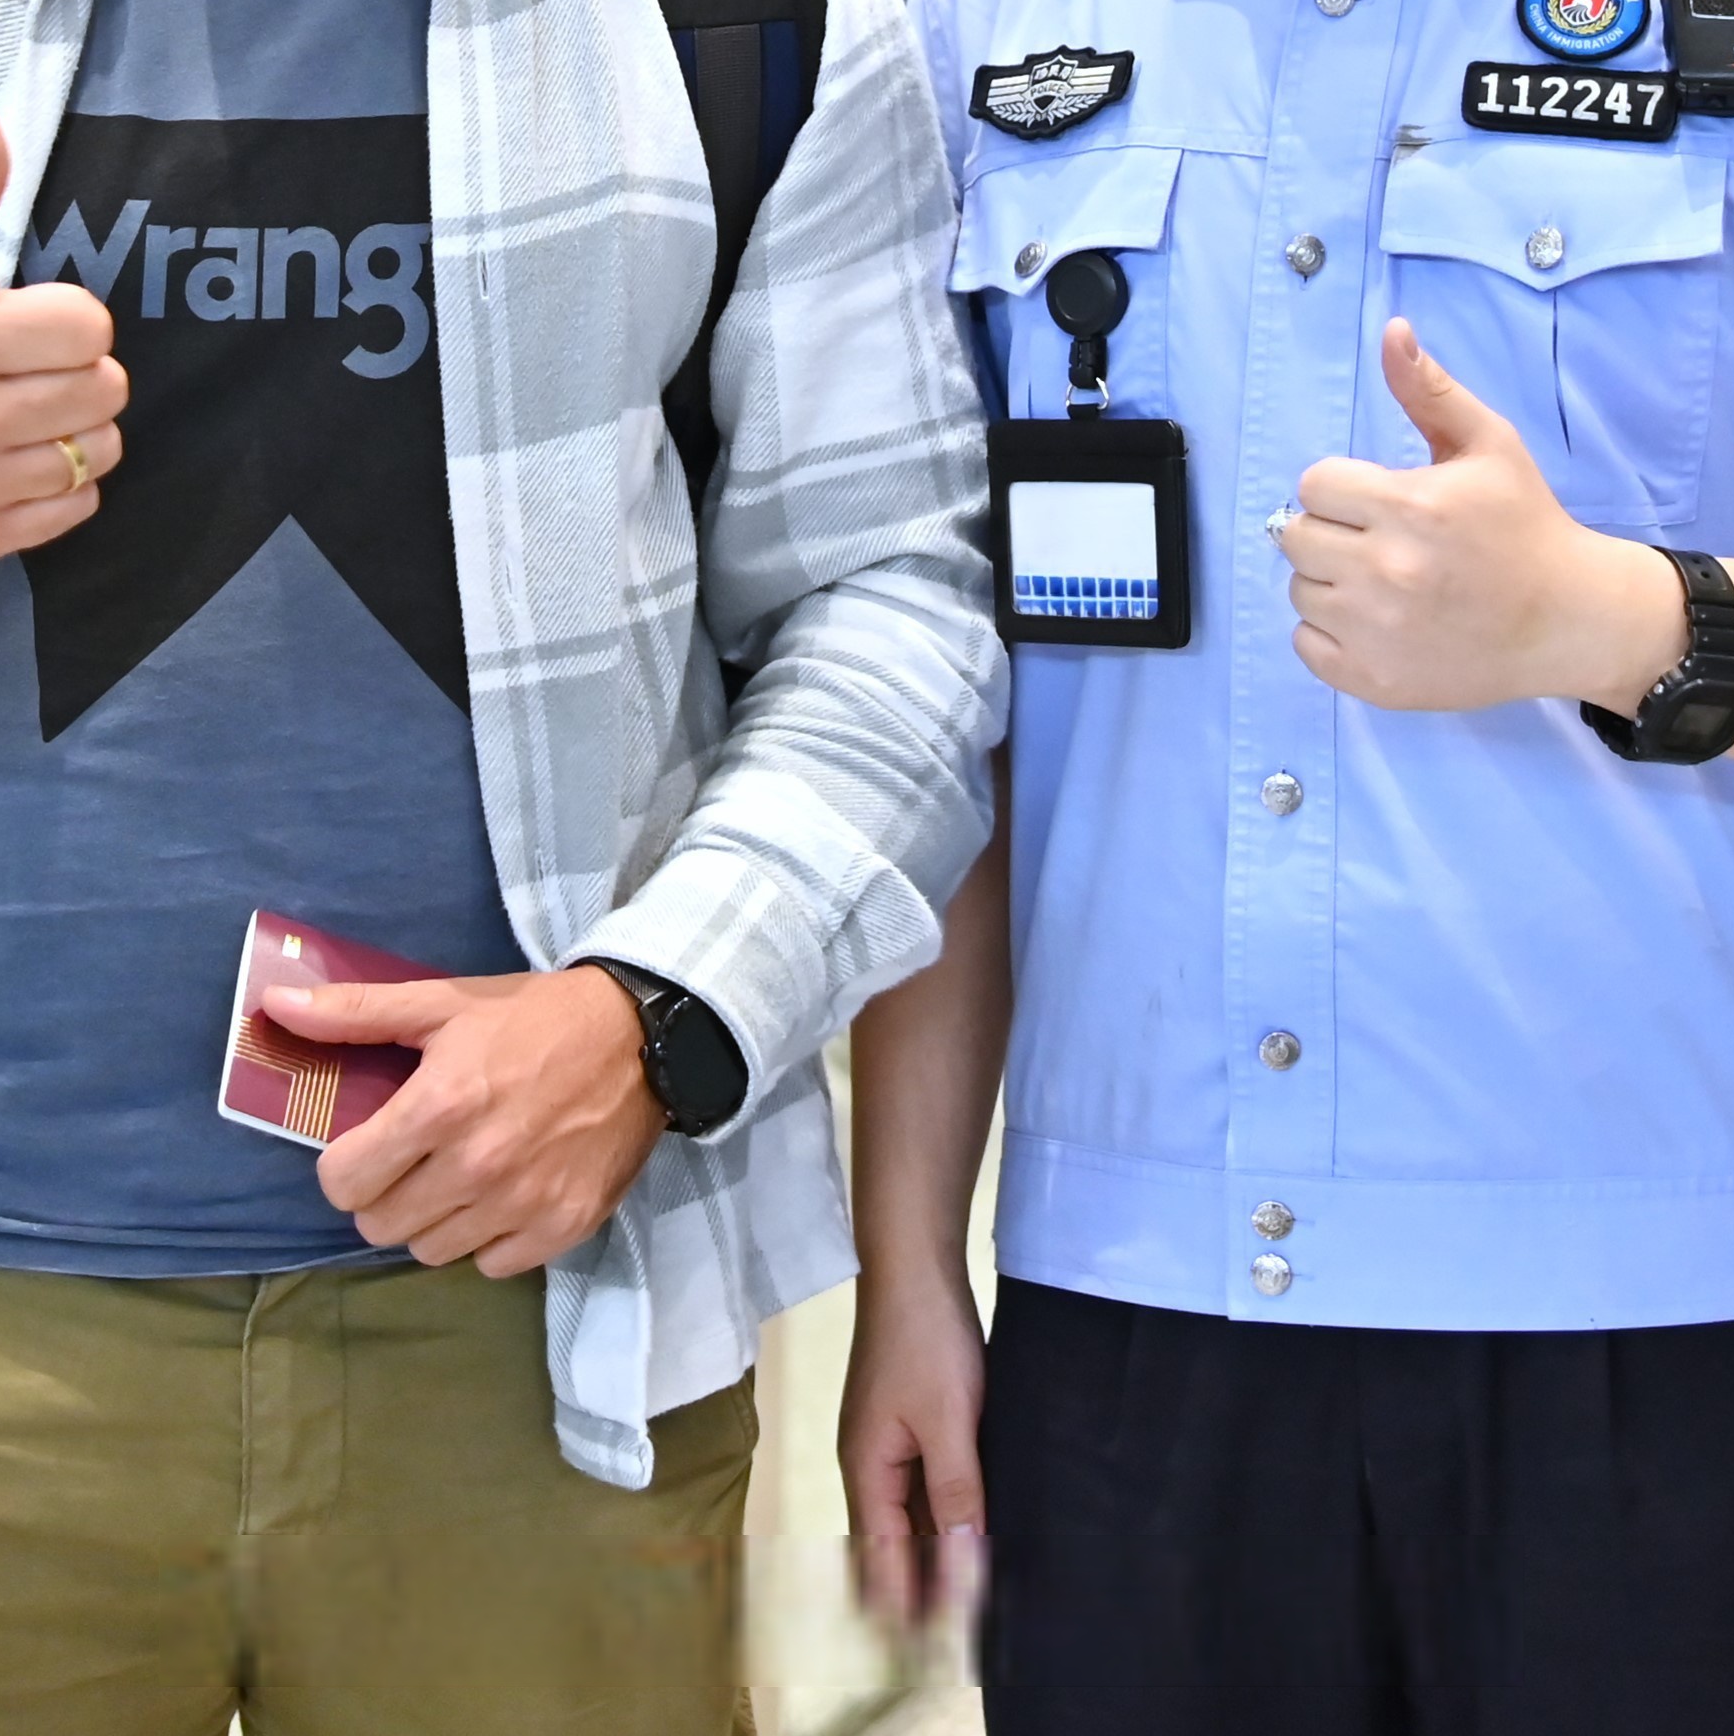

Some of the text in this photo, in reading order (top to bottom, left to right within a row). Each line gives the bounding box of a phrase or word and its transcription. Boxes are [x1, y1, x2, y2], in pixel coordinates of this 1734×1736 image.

[1547, 27, 1624, 50] IMMIGRATION
[1031, 83, 1065, 96] POLICE
[1477, 72, 1665, 126] 112247
